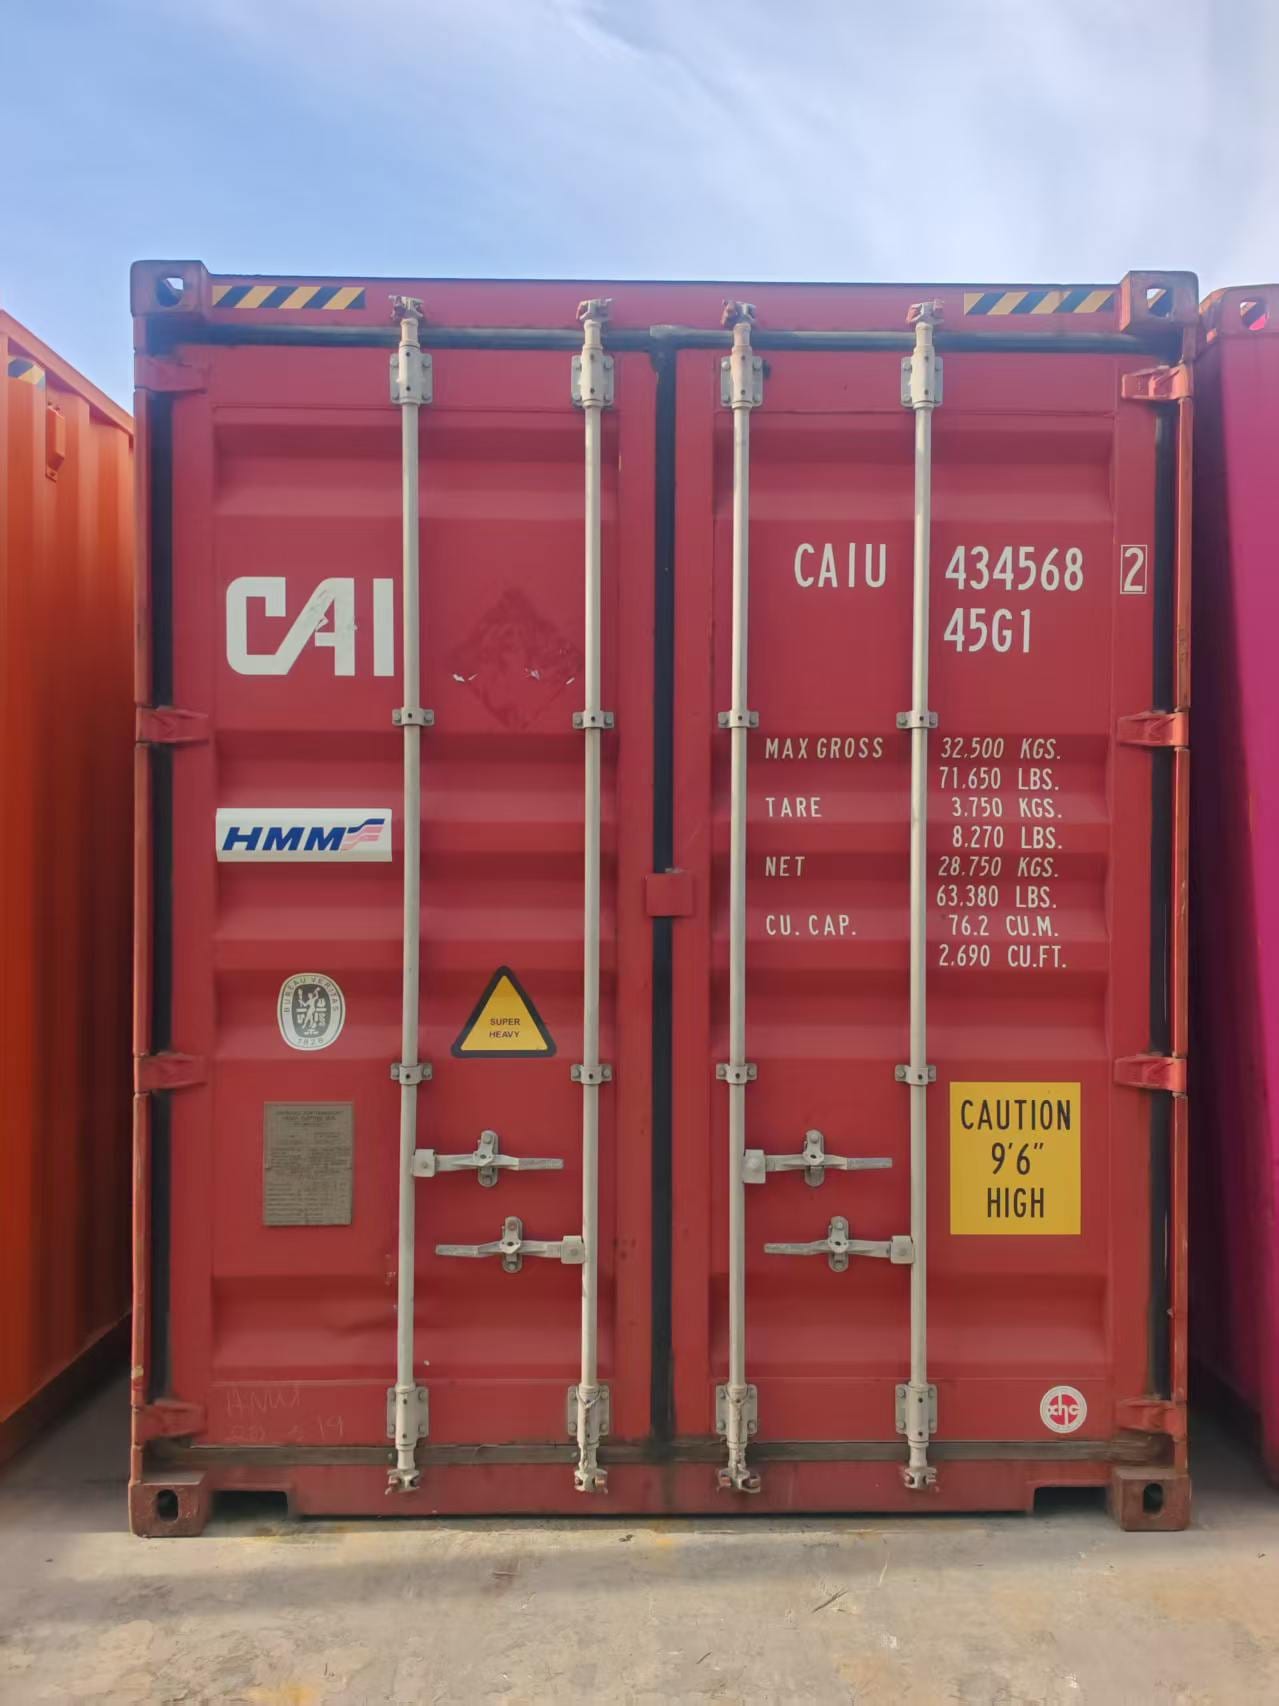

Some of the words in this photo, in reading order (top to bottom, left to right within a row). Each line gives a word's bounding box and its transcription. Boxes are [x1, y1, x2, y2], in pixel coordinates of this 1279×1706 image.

[794, 542, 887, 588] CAIU
[945, 545, 1084, 592] 434568
[1123, 547, 1144, 592] 2
[226, 576, 394, 677] CAI
[943, 607, 1031, 653] 45G1
[765, 737, 809, 759] MAX
[816, 737, 883, 759] GROSS
[1020, 737, 1062, 760] KGS.
[1018, 767, 1059, 791] LBS.
[765, 796, 822, 818] TARE
[1018, 797, 1062, 819] KGS.
[222, 826, 347, 851] HMM
[1021, 826, 1063, 849] LBS.
[765, 855, 806, 877] NET
[1017, 856, 1059, 878] KGS.
[1015, 885, 1057, 909] LBS.
[766, 914, 800, 936] CU.
[808, 914, 857, 936] CAP.
[948, 914, 990, 936] 76.2
[1005, 915, 1059, 937] CU.M.
[1007, 944, 1067, 968] CU.FT.
[283, 977, 306, 1013] BUREAU
[311, 975, 339, 1012] VERITAS
[490, 1018, 521, 1026] SUPER
[961, 1099, 1071, 1130] CAUTION
[987, 1187, 1044, 1218] HIGH
